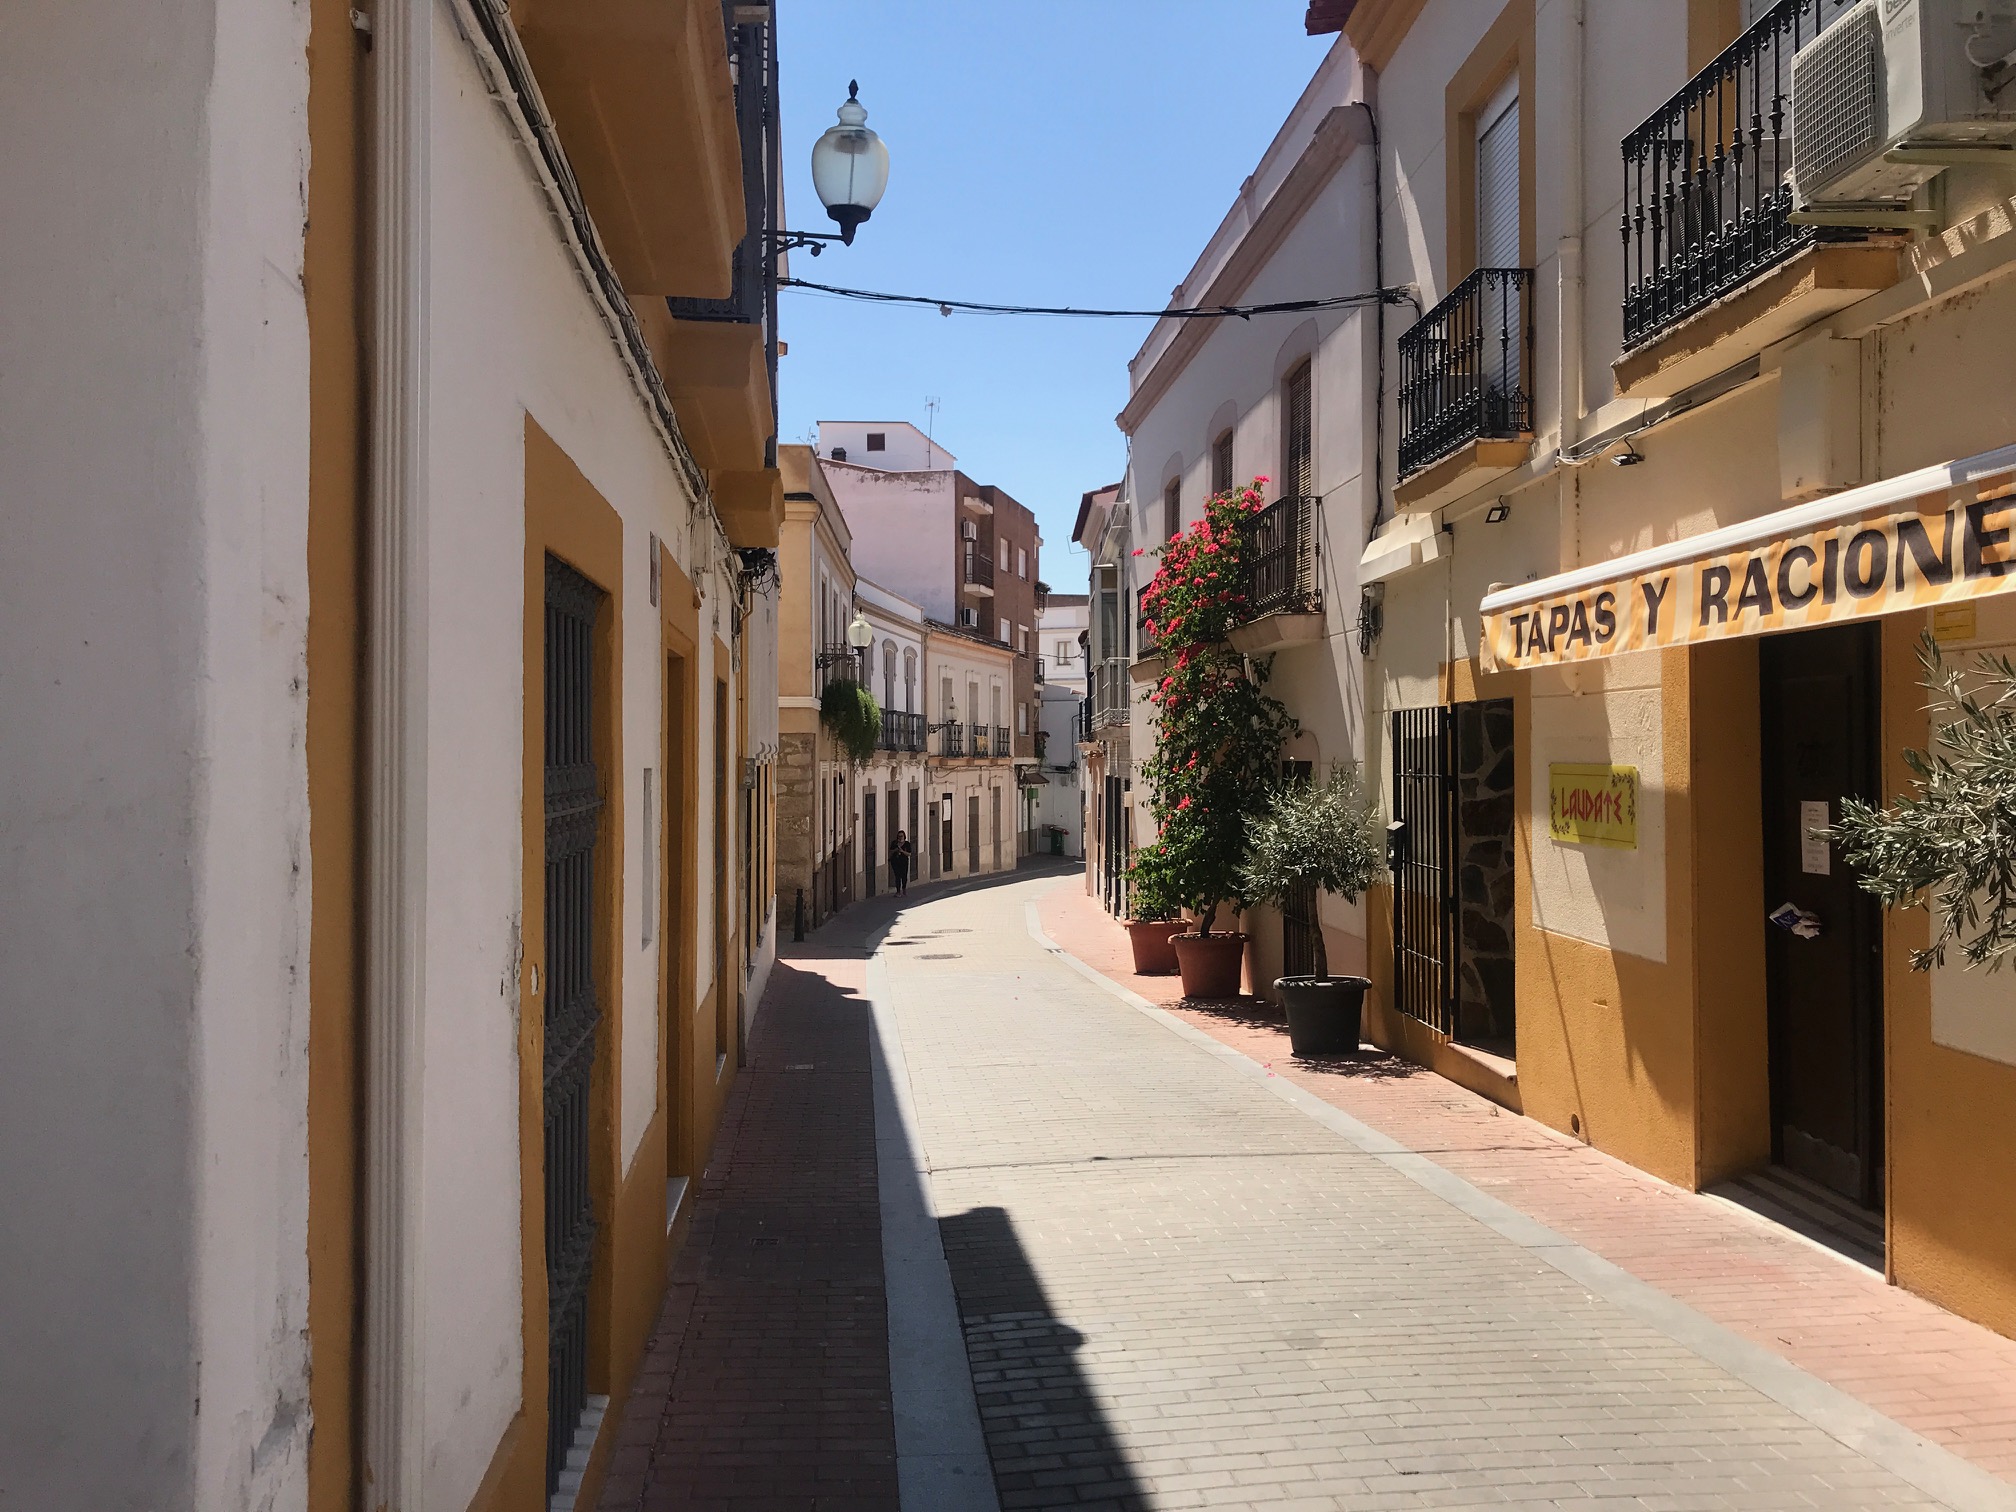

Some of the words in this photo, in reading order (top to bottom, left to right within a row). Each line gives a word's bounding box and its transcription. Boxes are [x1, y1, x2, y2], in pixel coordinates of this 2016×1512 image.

[1510, 591, 1616, 658] TAPAS
[1641, 577, 1670, 635] Y
[1700, 494, 2016, 627] RACIONE
[1561, 787, 1623, 825] LAUDATE
